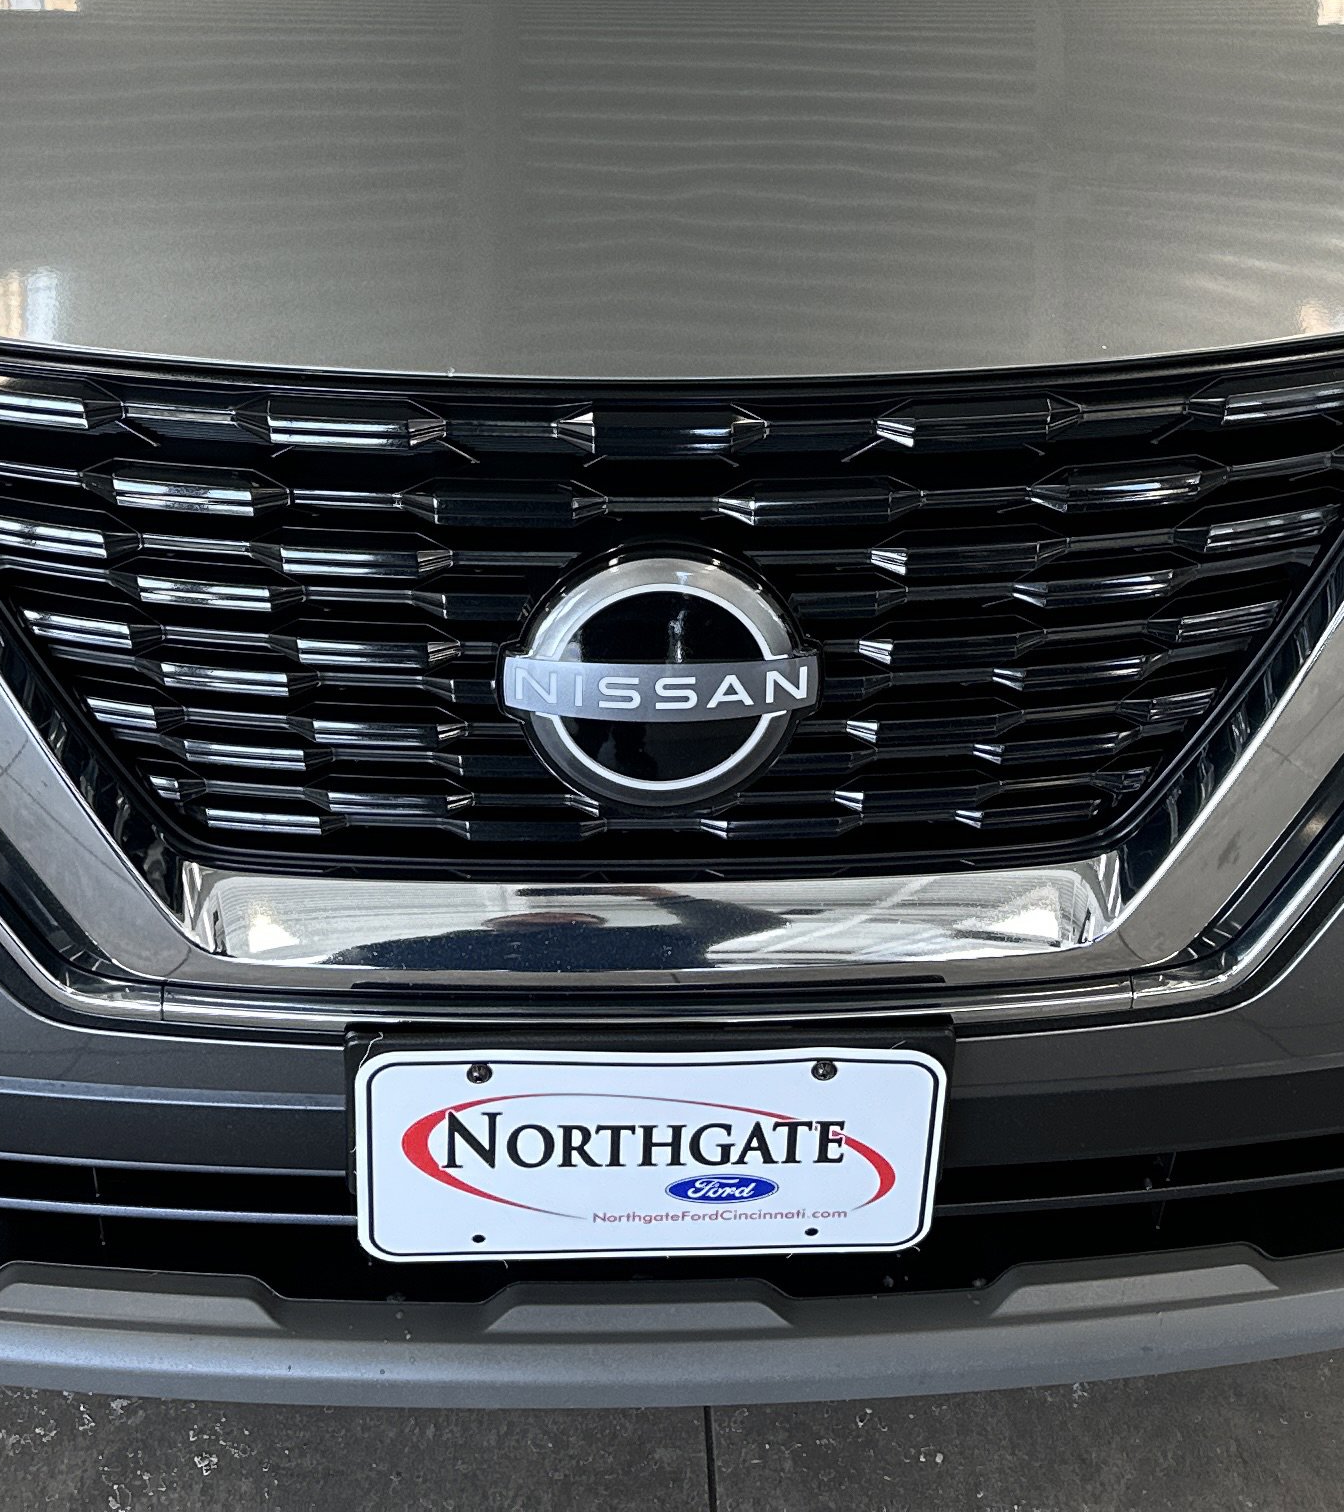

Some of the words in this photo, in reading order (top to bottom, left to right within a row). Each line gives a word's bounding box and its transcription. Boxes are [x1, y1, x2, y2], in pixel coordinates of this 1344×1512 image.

[512, 666, 809, 711] NISSAN
[441, 1111, 846, 1170] NORTHGATE
[687, 1178, 756, 1199] Ford
[593, 1209, 848, 1225] NorthgateFordCincinnati.com
